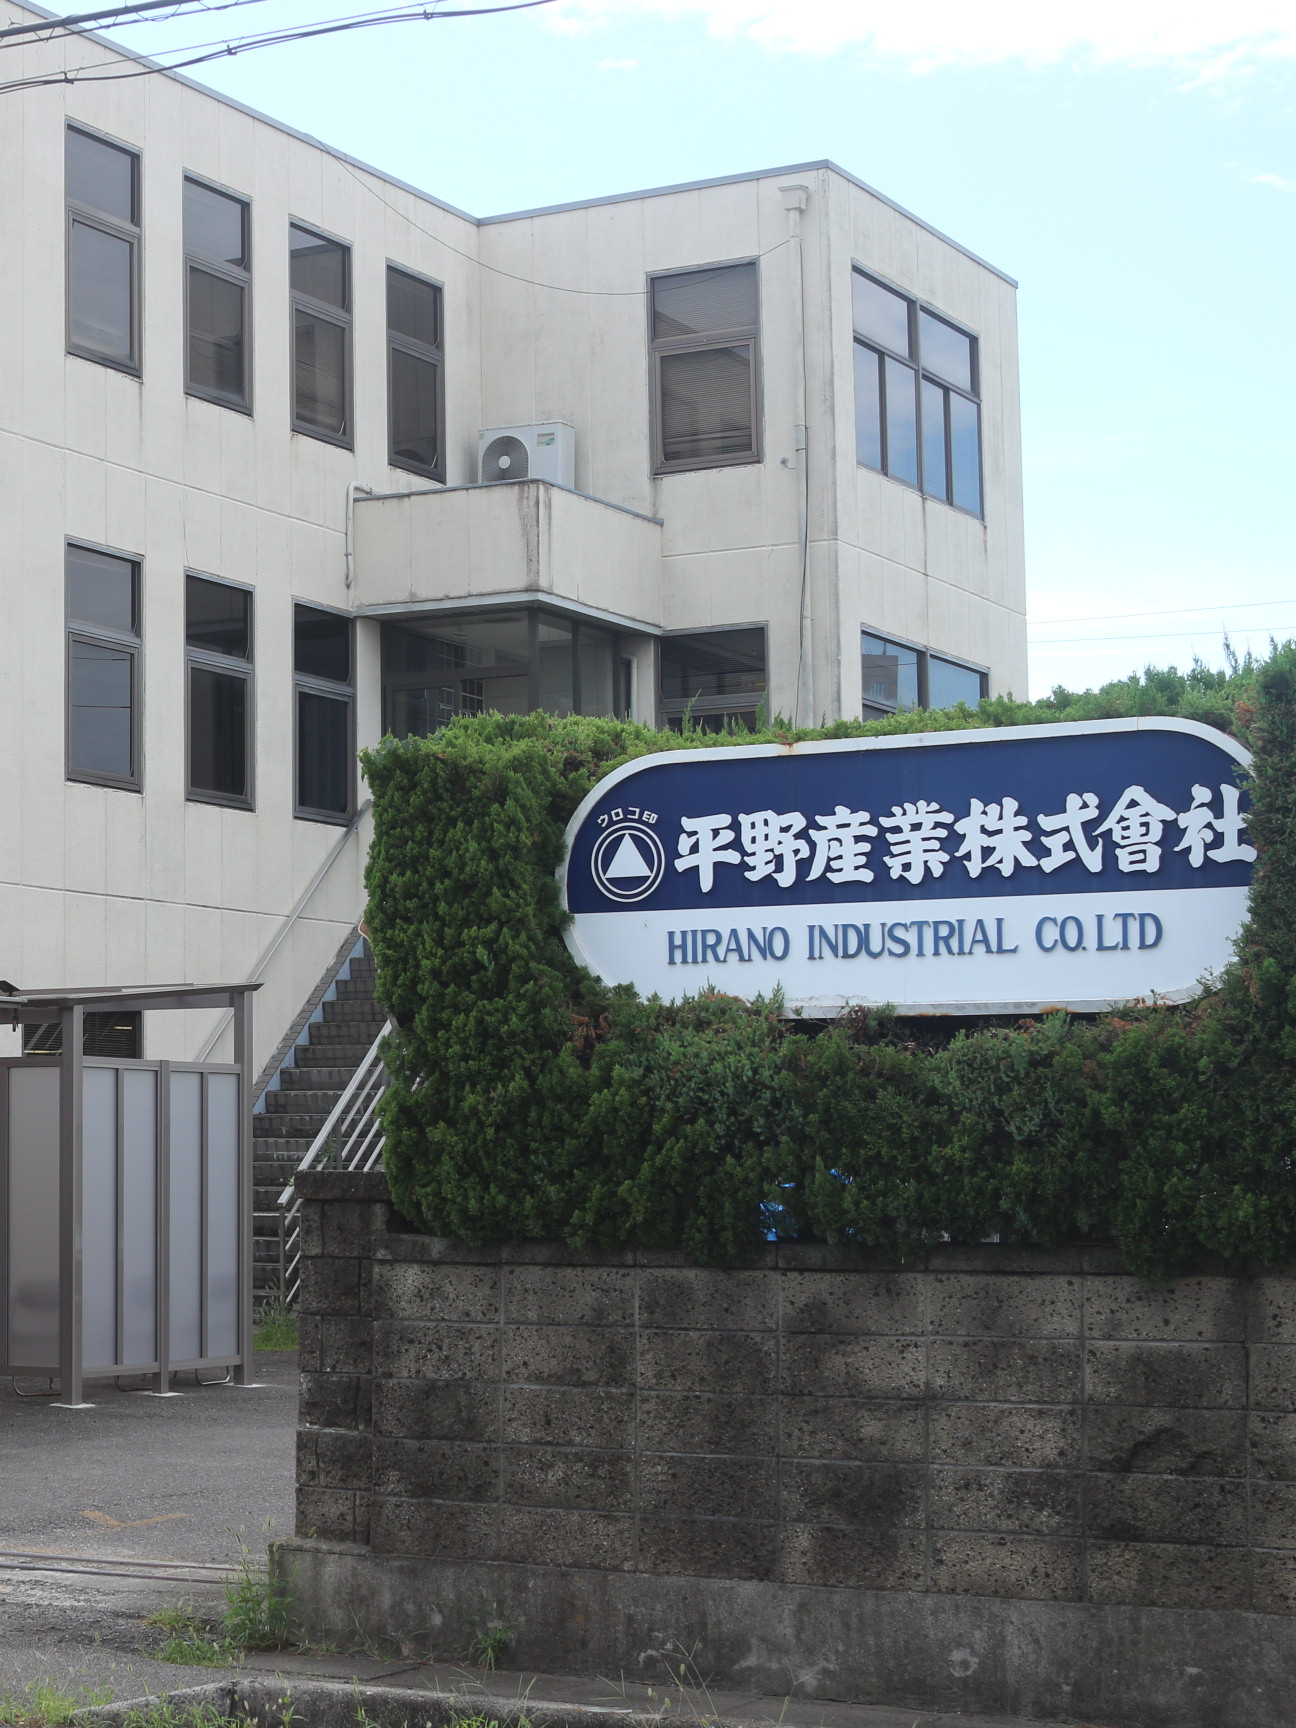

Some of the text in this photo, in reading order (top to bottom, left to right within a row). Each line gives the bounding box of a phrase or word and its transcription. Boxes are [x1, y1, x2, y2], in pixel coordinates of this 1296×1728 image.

[597, 807, 659, 827] ウロコ印
[674, 783, 1258, 893] 平野産業株式會社
[667, 926, 790, 965] HIRANO
[806, 917, 1019, 960] INDUSTRIAL
